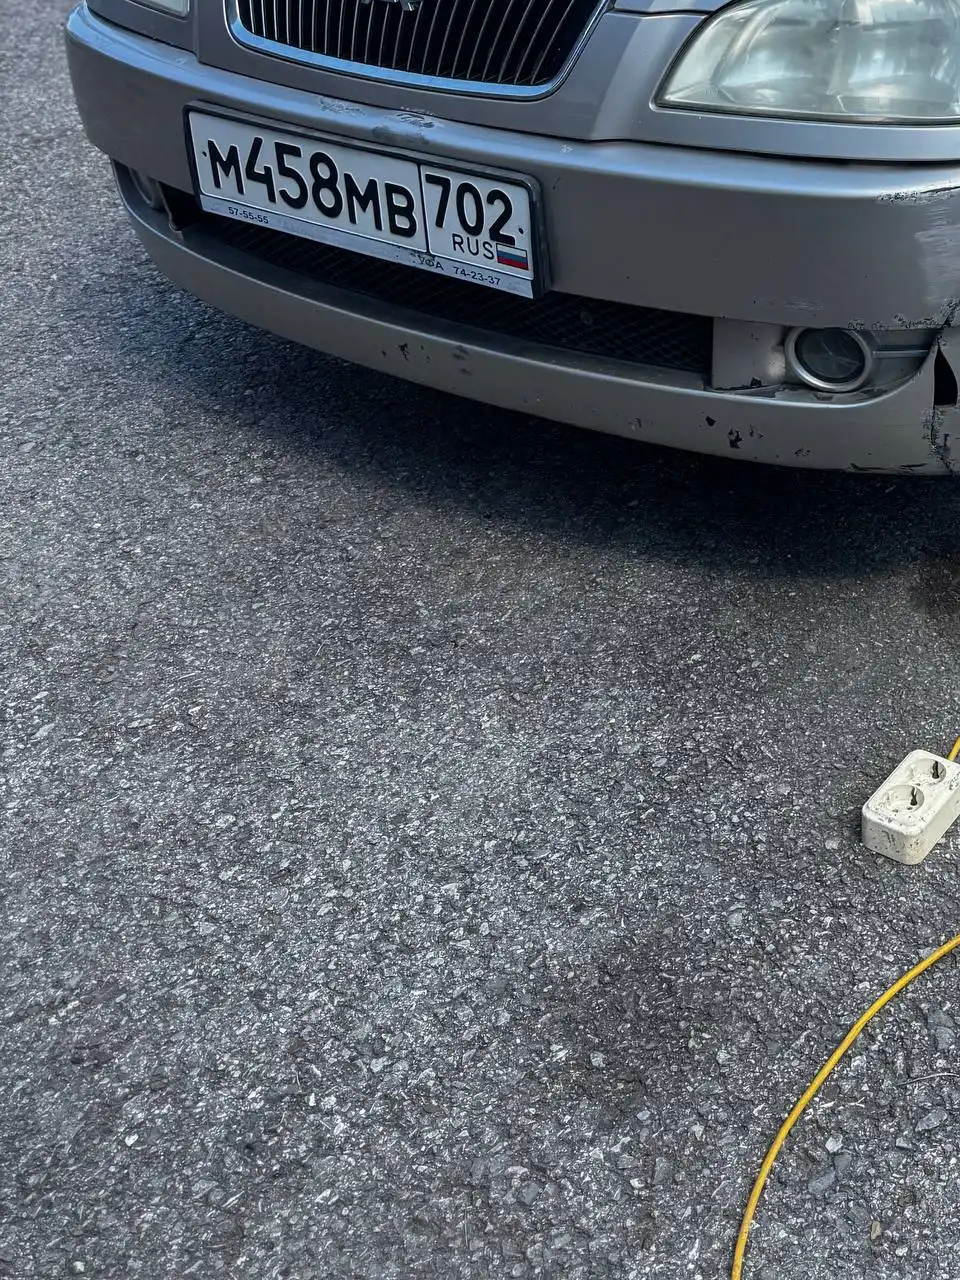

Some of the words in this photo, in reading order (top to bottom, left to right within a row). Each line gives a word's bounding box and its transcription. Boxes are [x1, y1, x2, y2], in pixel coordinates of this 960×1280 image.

[207, 137, 417, 238] М458МВ
[425, 173, 516, 246] 702
[451, 233, 495, 261] RUS
[452, 266, 501, 286] 74-23-37
